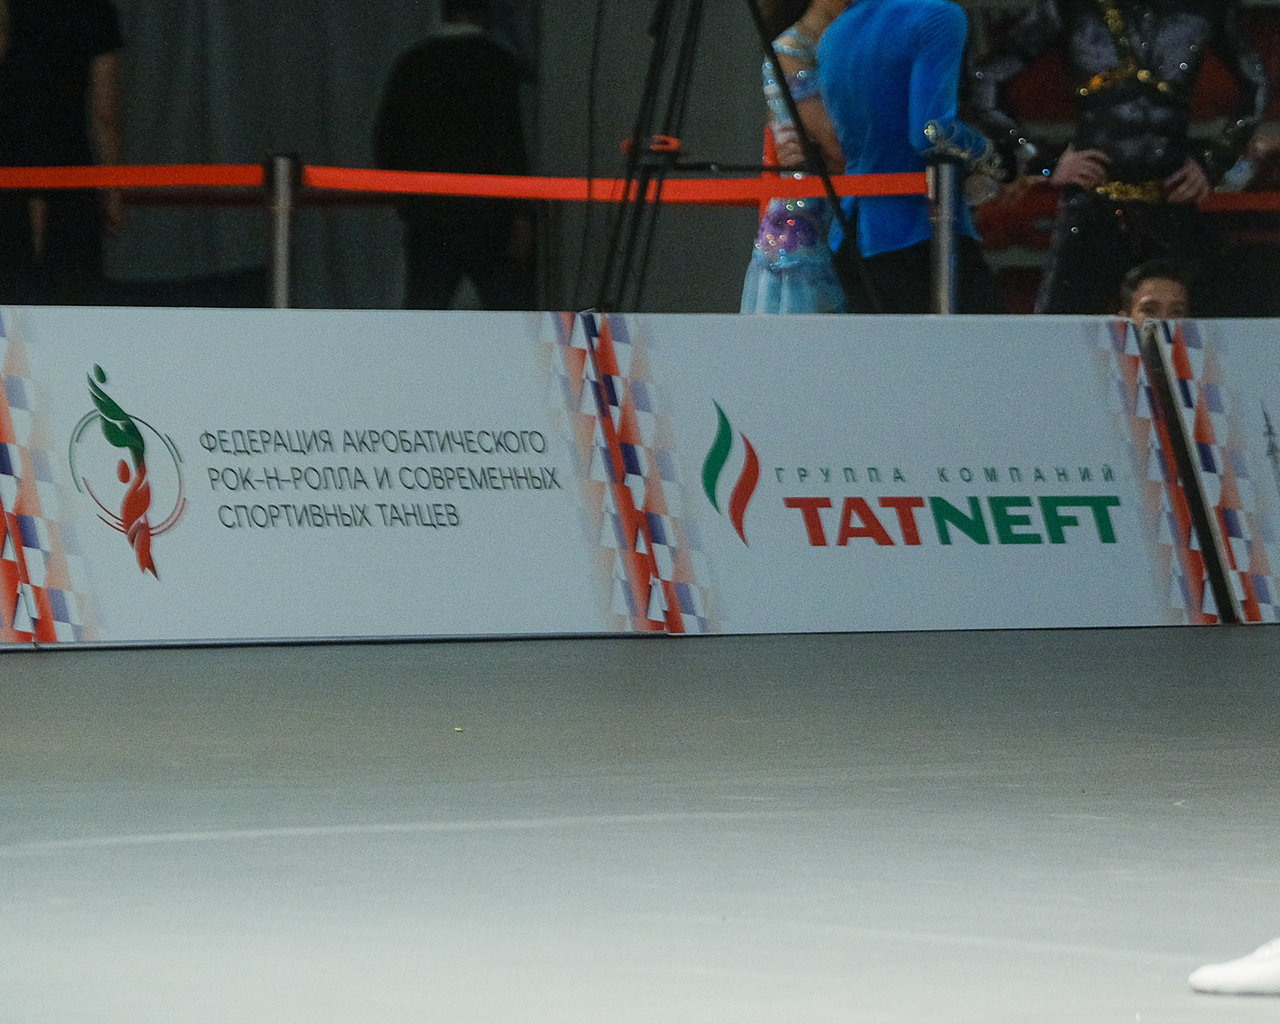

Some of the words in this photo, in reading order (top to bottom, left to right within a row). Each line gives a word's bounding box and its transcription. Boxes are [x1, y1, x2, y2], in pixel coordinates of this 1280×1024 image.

[199, 430, 334, 456] ФЕДЕРАЦИЯ
[342, 430, 547, 455] АКРОБАТИЧЕСКОГО
[208, 468, 368, 491] РОК-Н-РОЛЛА
[374, 466, 392, 491] И
[399, 466, 560, 491] СОВРЕМЕННЫХ
[774, 466, 906, 484] ГРУППА
[937, 464, 1117, 483] КОМПАНИЙ
[218, 504, 371, 529] СПОРТИВНЫХ
[376, 503, 460, 529] ТАНЦЕВ
[784, 495, 1121, 547] TATNEFT
